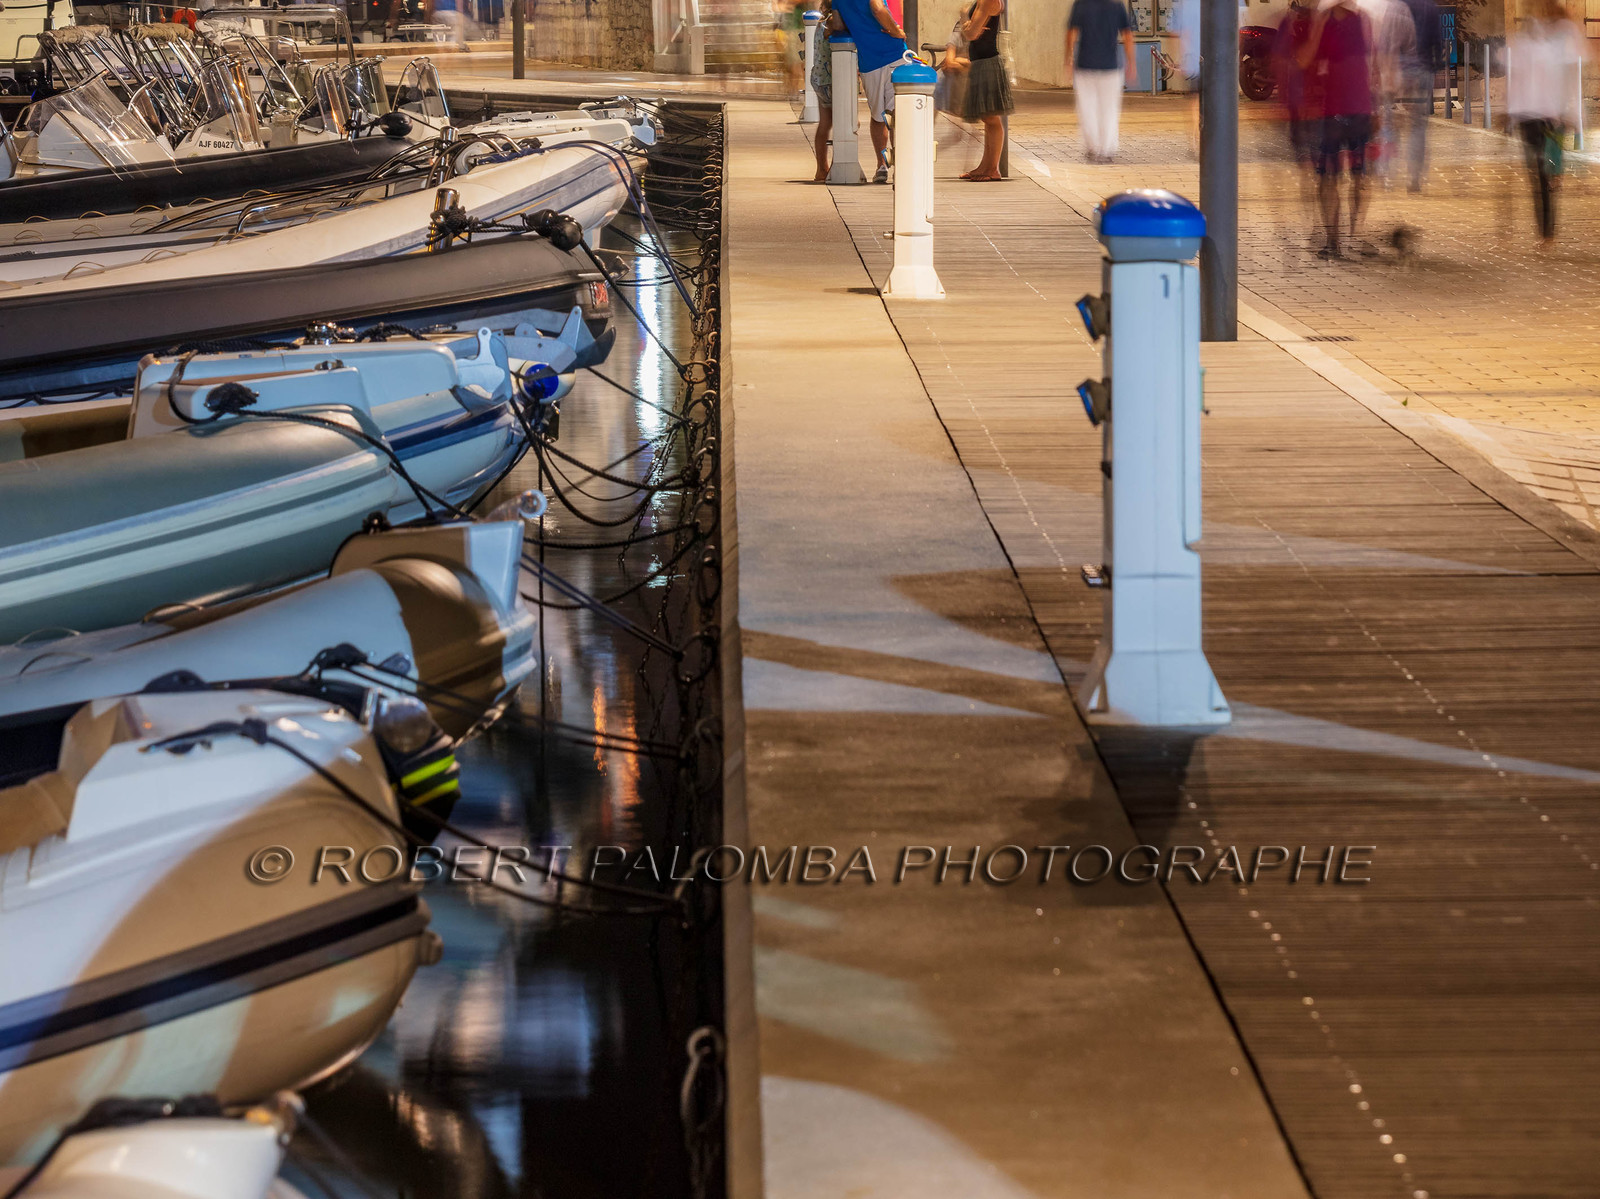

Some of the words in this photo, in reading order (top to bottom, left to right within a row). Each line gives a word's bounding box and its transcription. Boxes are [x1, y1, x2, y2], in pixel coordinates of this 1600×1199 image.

[915, 98, 924, 110] 3
[198, 140, 211, 148] AJF
[213, 140, 234, 149] 60427
[1160, 273, 1170, 299] 1
